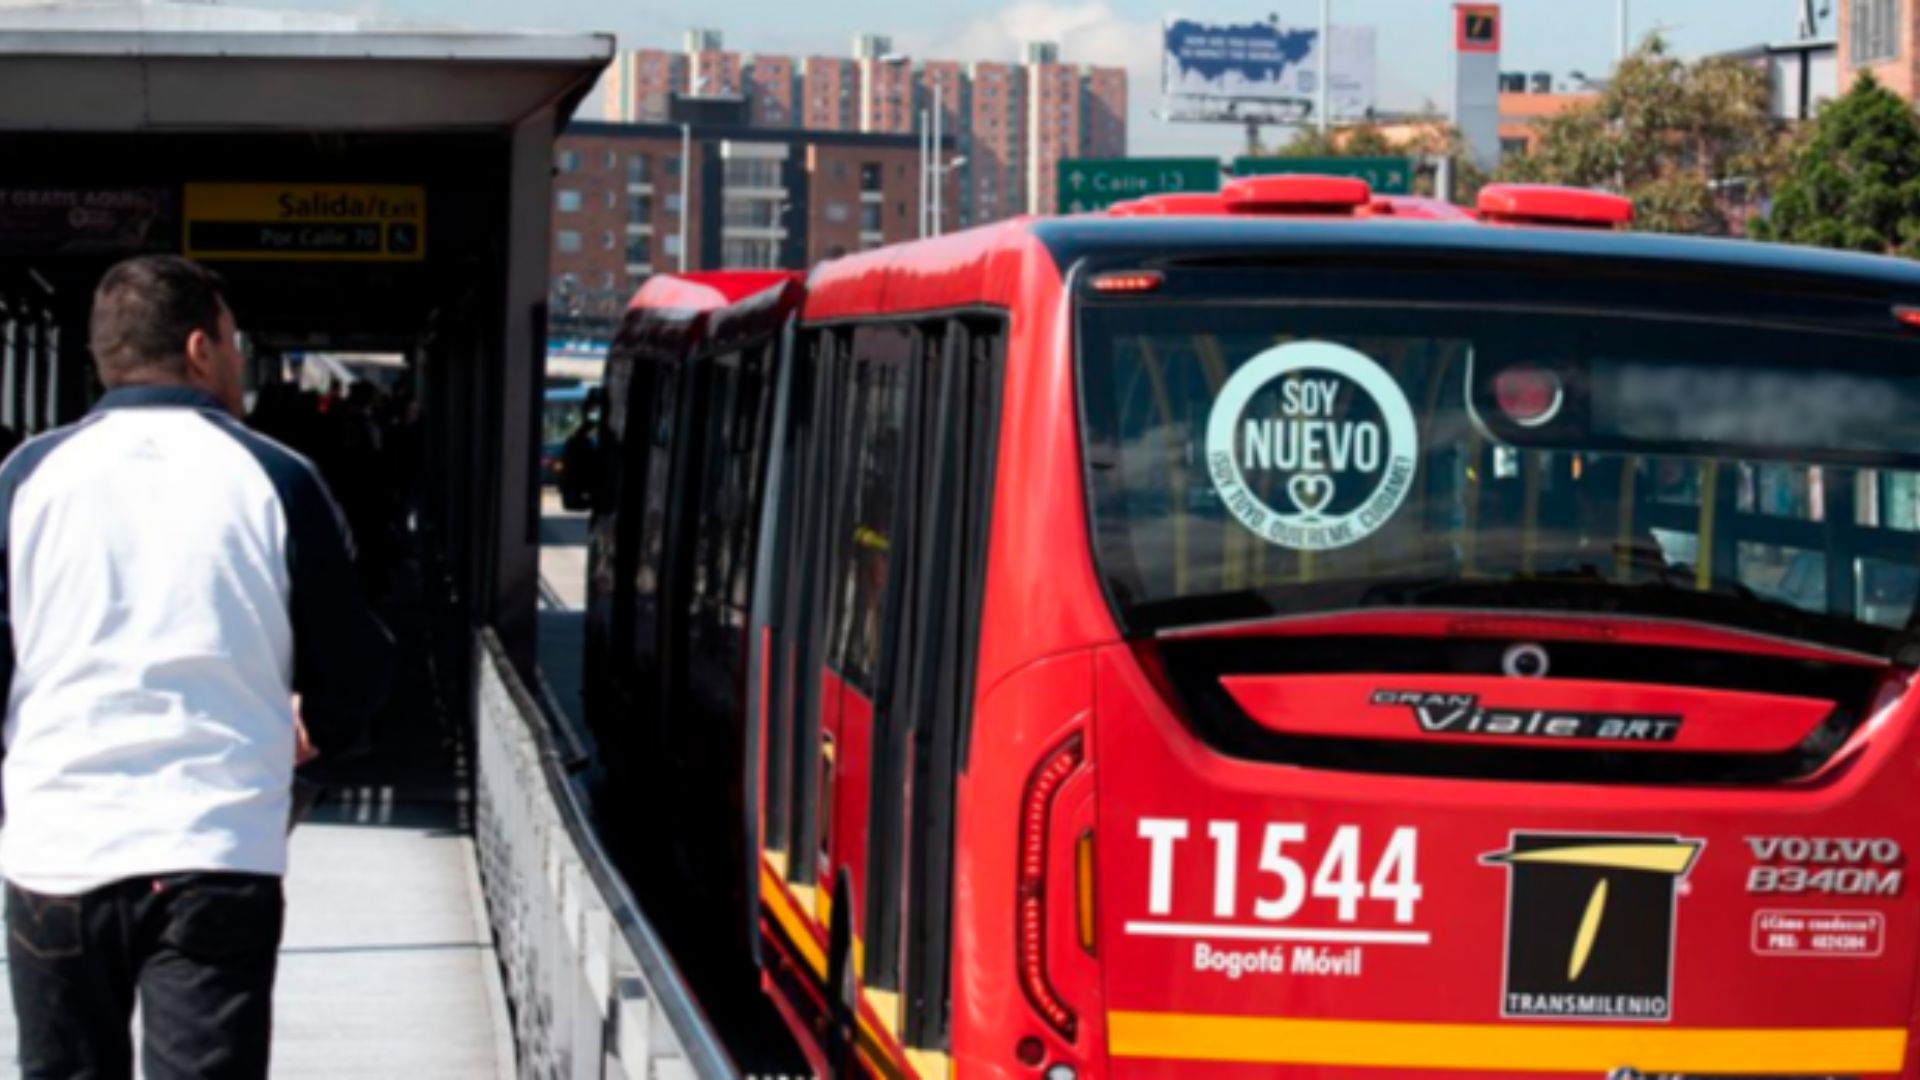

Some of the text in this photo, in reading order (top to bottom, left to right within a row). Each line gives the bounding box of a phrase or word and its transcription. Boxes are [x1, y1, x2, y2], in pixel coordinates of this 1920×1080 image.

[1093, 170, 1184, 190] Calle 13
[260, 227, 378, 247] Por Calle 70
[1282, 379, 1339, 416] SOY
[1244, 419, 1380, 472] NUEVO
[1373, 689, 1475, 706] GRAN
[1416, 705, 1677, 740] Viale BRT
[1743, 836, 1901, 864] VOLVO
[1137, 817, 1422, 924] T1544
[1745, 865, 1902, 895] B340M
[1193, 942, 1362, 980] Bogotá Móvil
[1508, 993, 1667, 1017] TRANSMILENIO
